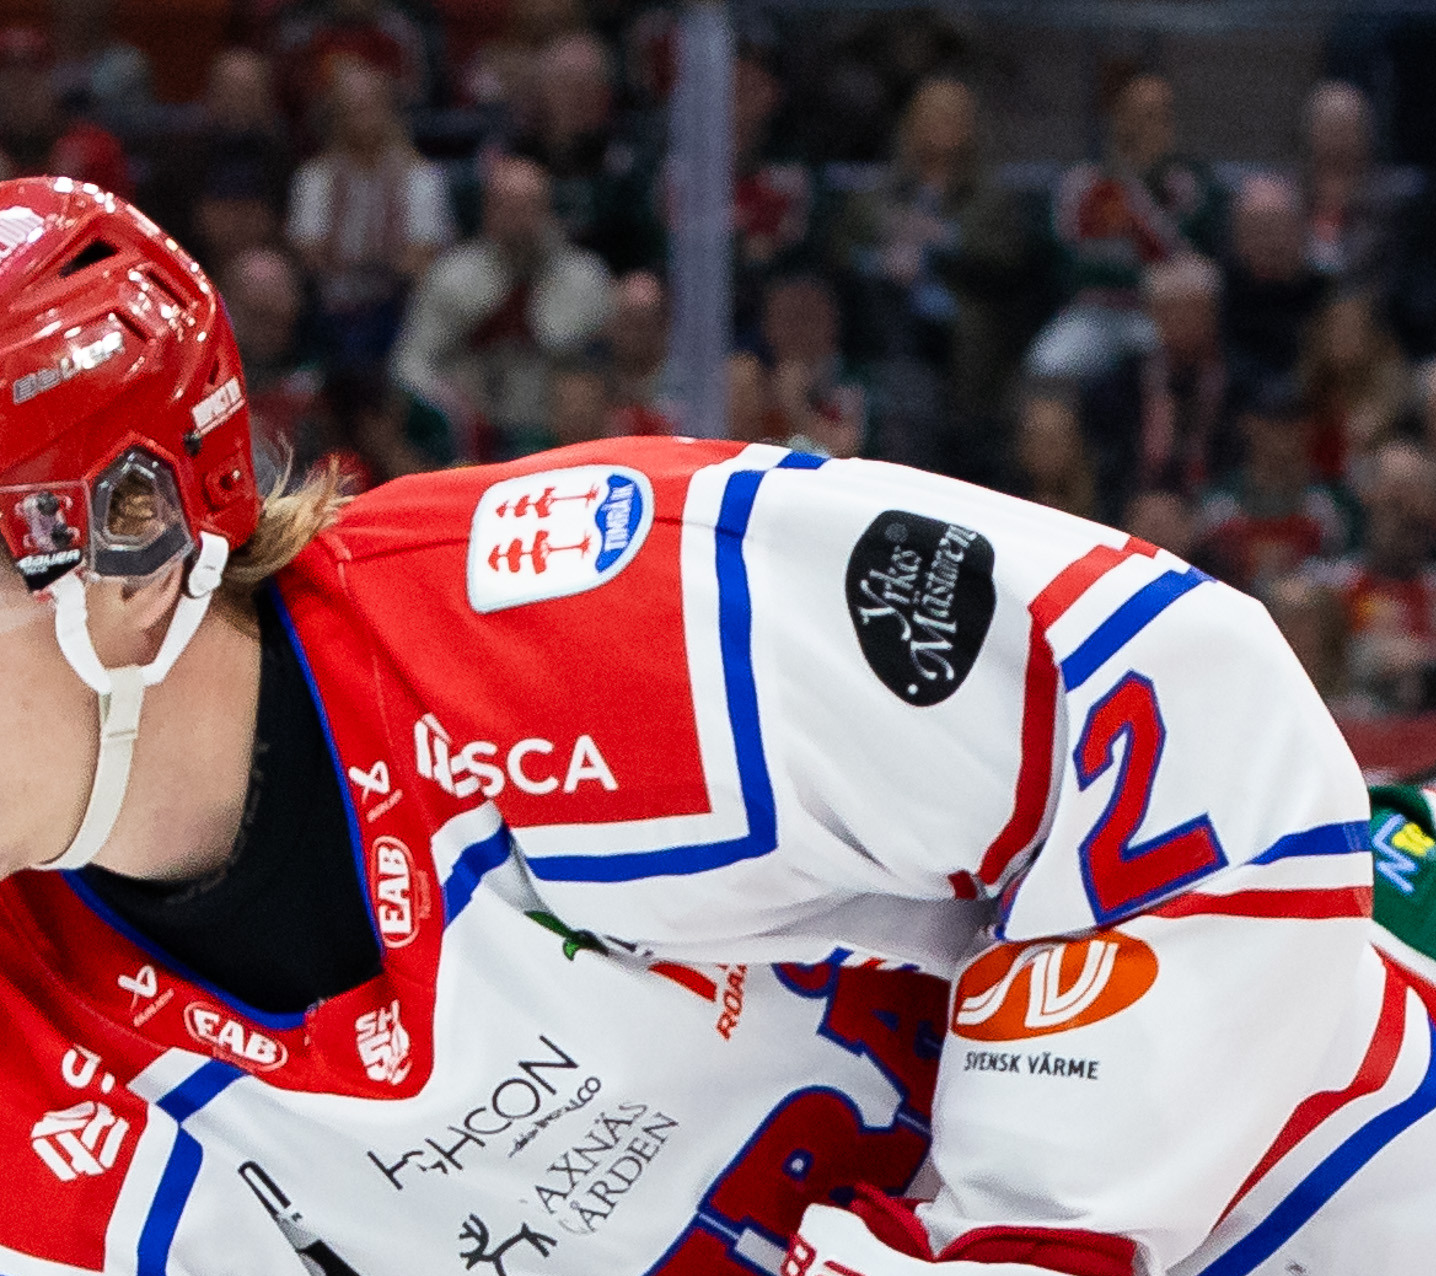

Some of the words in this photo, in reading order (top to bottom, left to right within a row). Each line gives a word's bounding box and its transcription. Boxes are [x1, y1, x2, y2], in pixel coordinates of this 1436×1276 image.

[378, 847, 413, 934] EAB
[192, 1007, 277, 1065] EAB
[963, 1050, 1022, 1074] SVENSK
[1027, 1051, 1100, 1081] VÄRME
